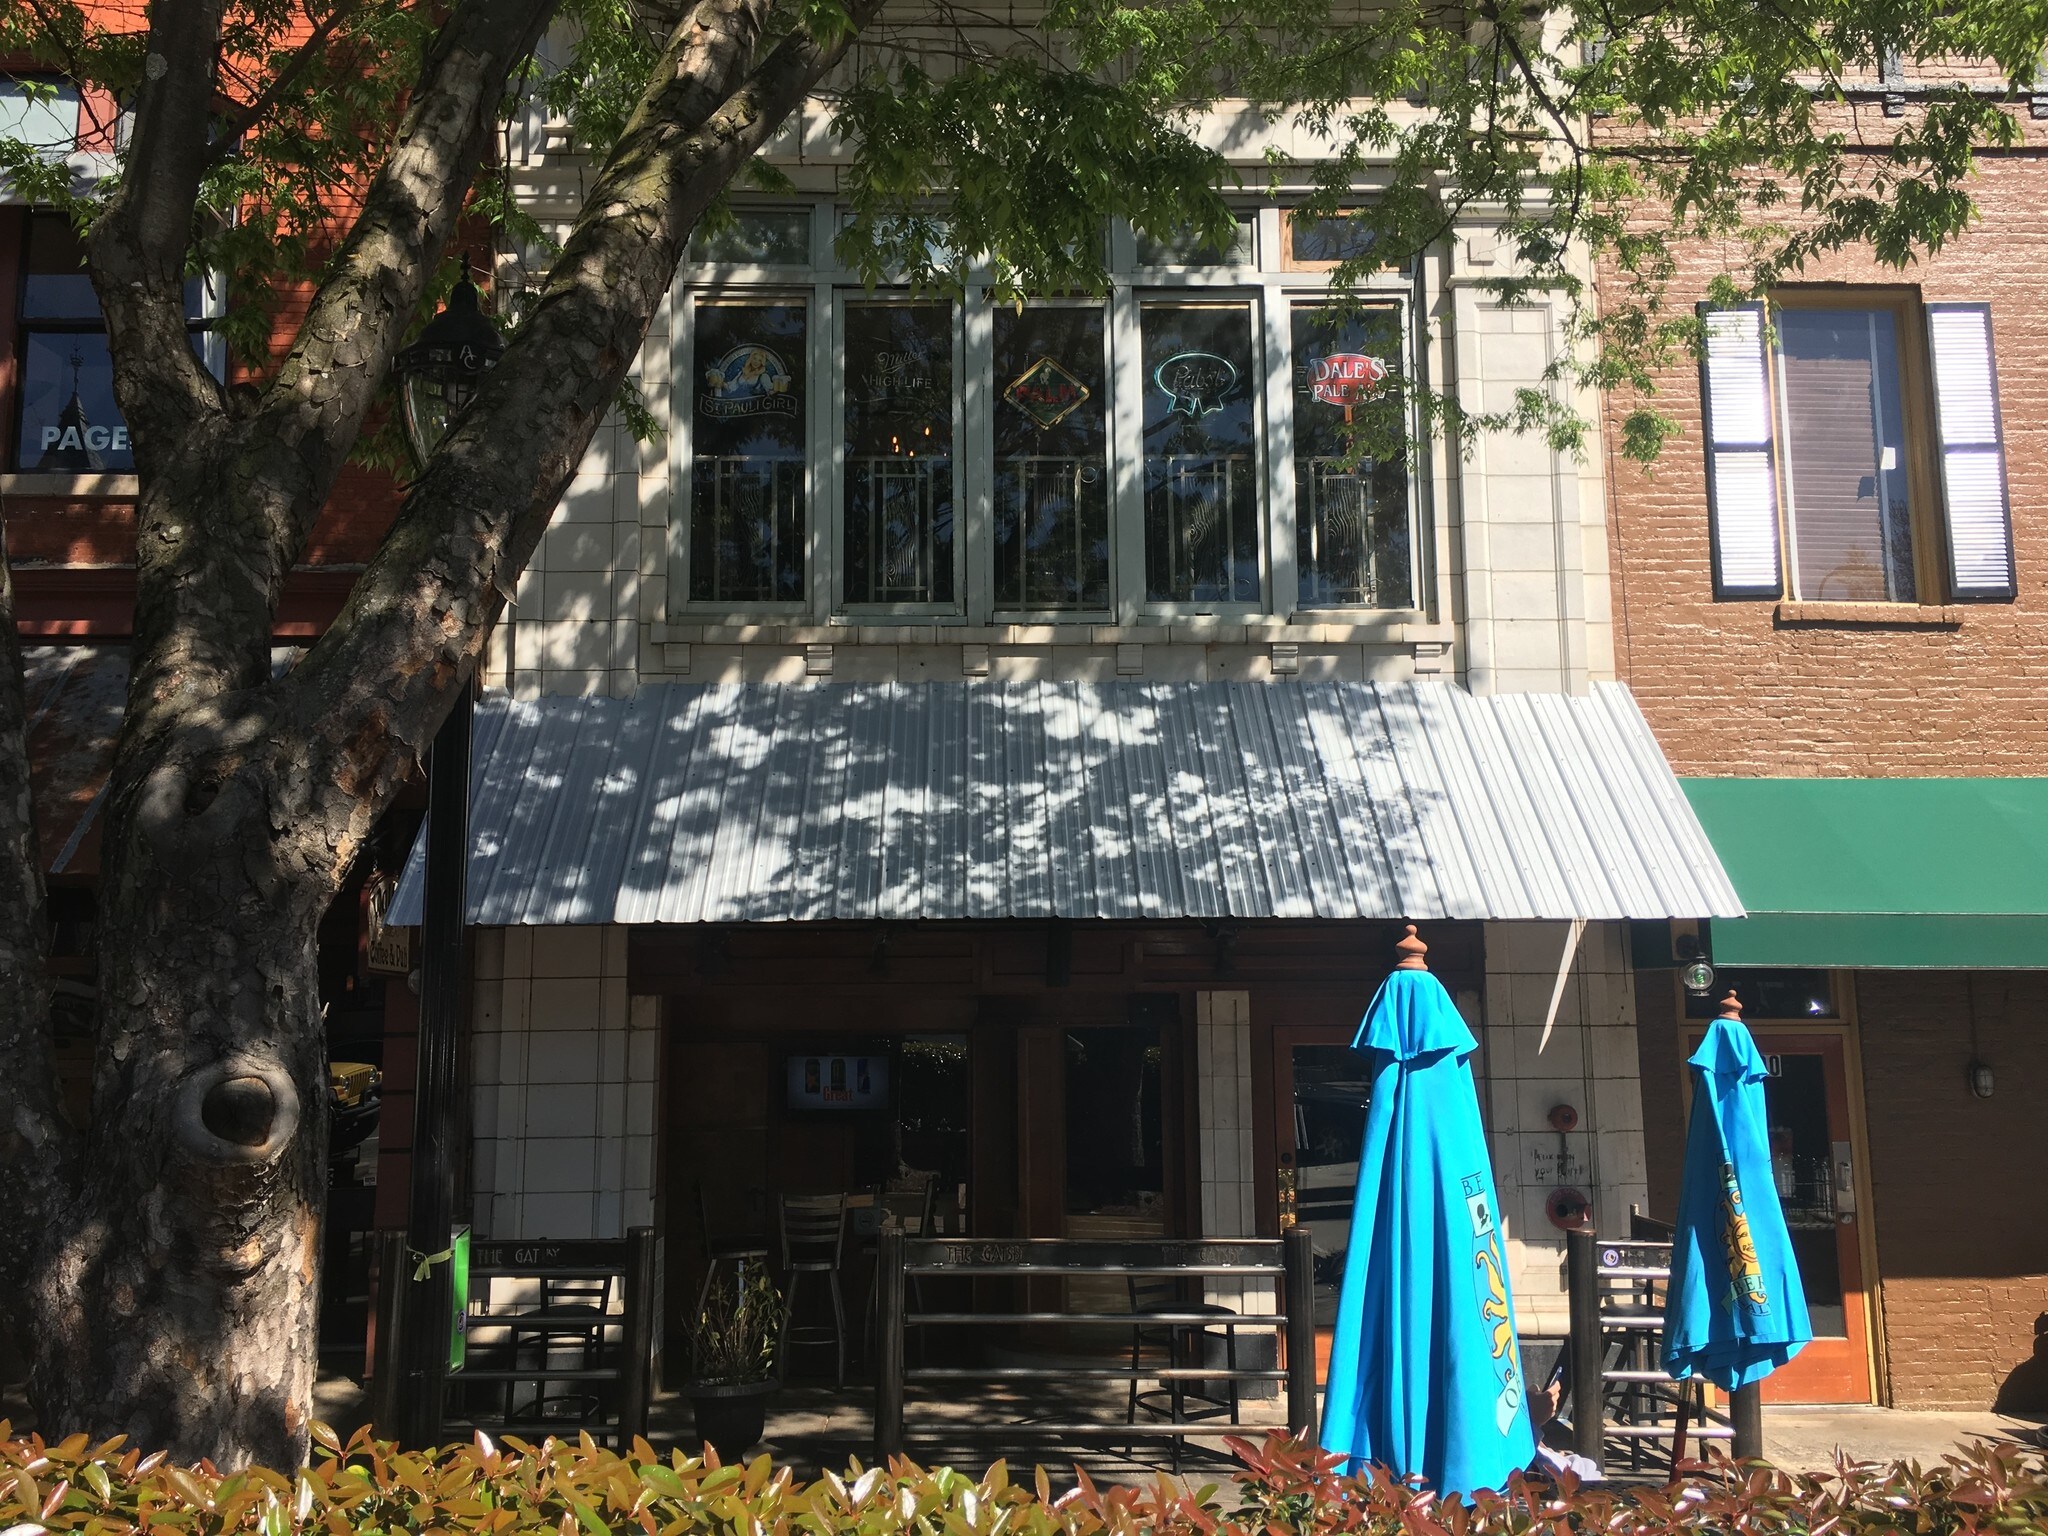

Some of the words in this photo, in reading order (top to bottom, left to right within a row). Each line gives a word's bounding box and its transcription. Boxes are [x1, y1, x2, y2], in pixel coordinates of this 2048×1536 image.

[877, 351, 921, 369] Miller
[1311, 358, 1386, 381] DALE'S
[869, 375, 901, 387] HIGH
[904, 376, 932, 389] LIFE
[1173, 365, 1226, 391] Pabst
[1014, 383, 1077, 404] PALM
[1312, 384, 1350, 401] PALE
[724, 400, 760, 415] PAULI
[762, 396, 795, 410] GIRL
[40, 425, 133, 451] PAGE
[945, 1245, 973, 1264] THE
